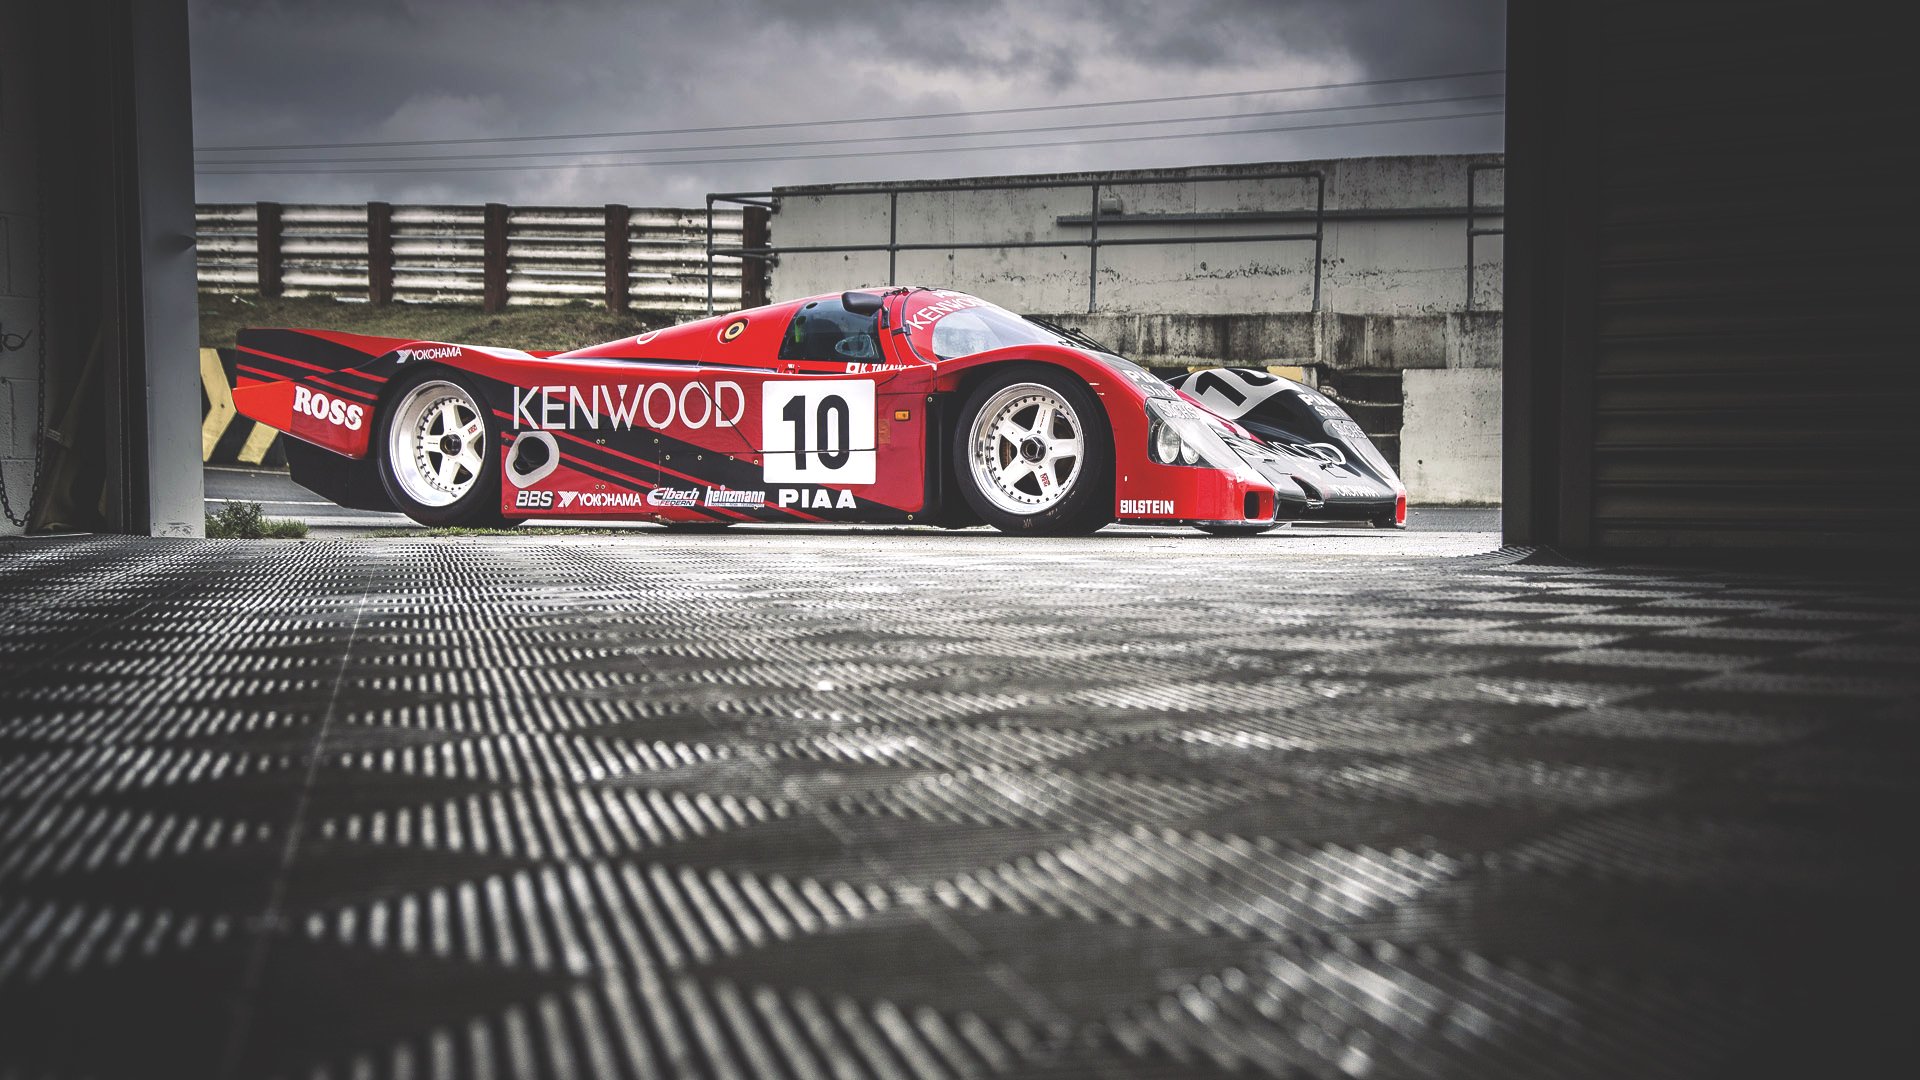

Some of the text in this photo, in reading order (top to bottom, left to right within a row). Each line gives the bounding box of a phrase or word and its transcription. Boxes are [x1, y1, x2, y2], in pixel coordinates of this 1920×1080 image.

[411, 347, 462, 361] YOKOHAMA
[293, 385, 364, 431] ROSS
[513, 380, 745, 431] KENWOOD
[782, 394, 850, 470] 10
[515, 490, 554, 508] BBS
[578, 492, 642, 507] YOKOHAMA
[647, 487, 700, 506] Eibach
[704, 484, 766, 507] heinzmann
[778, 488, 857, 509] PIAA
[1120, 499, 1174, 515] BILSTEIN
